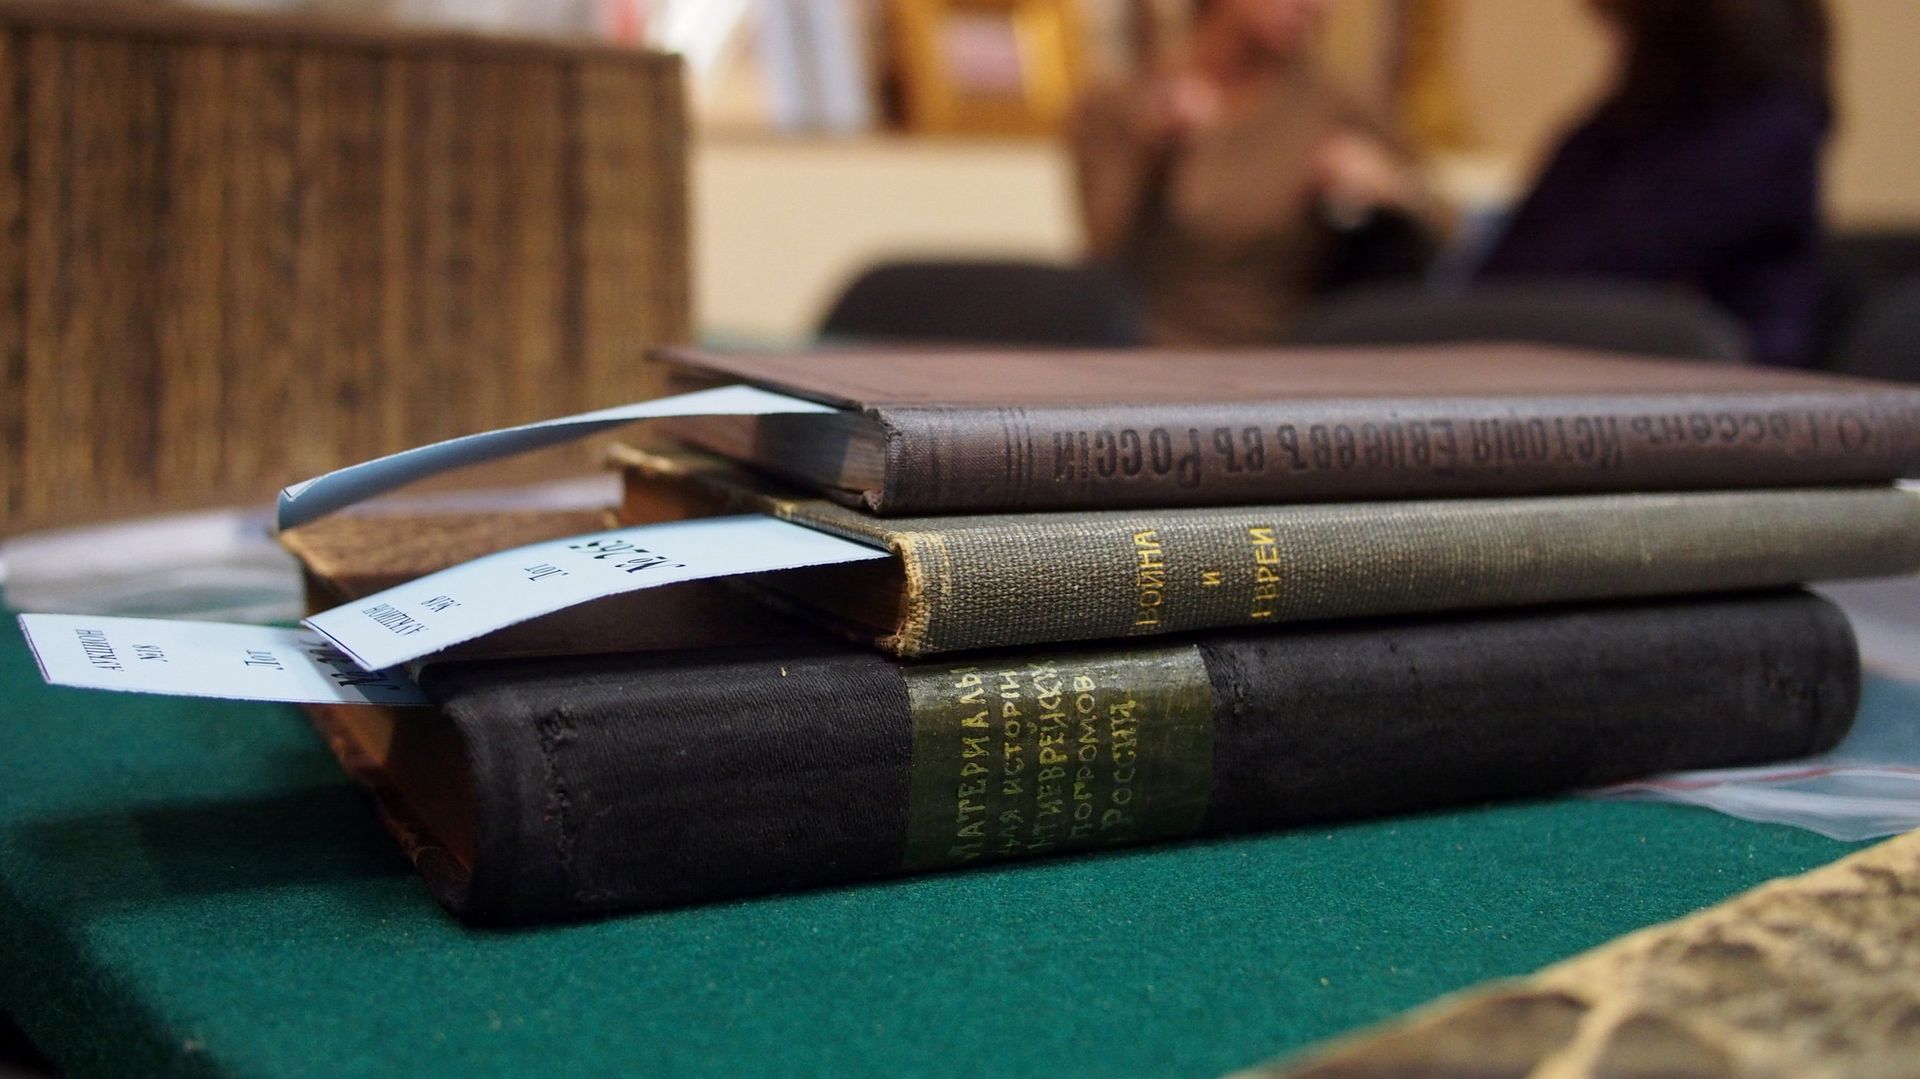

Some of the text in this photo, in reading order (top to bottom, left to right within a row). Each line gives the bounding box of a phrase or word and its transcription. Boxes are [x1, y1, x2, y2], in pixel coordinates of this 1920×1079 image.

[1053, 428, 1201, 488] Россіи
[1213, 424, 1264, 473] въ
[524, 563, 569, 581] Лот
[1133, 529, 1164, 626] ВОЙНА
[362, 603, 429, 635] АУКЦИОН
[420, 596, 461, 612] №18
[76, 629, 124, 672] АУКЦИОН
[132, 644, 168, 662] №18
[243, 650, 284, 670] Лот
